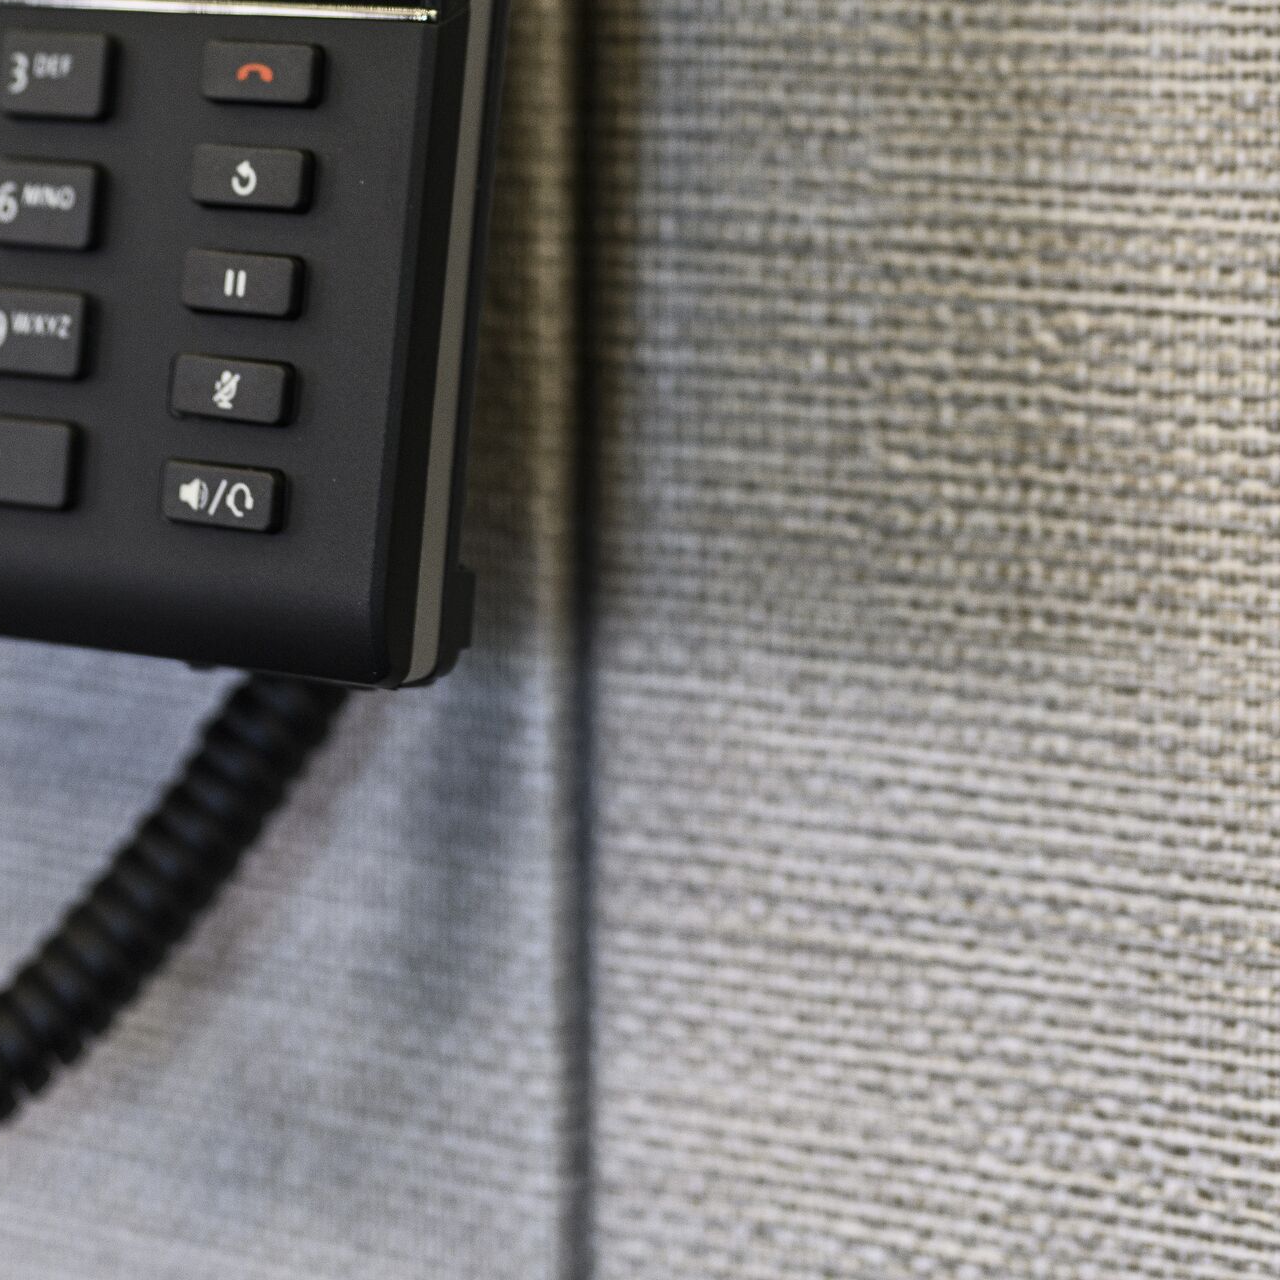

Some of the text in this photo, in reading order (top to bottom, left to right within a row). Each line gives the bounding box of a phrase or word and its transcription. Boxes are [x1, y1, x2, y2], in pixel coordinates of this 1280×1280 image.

[8, 51, 73, 94] 3 DEF
[22, 183, 76, 211] MNO
[11, 310, 72, 340] WXYZ
